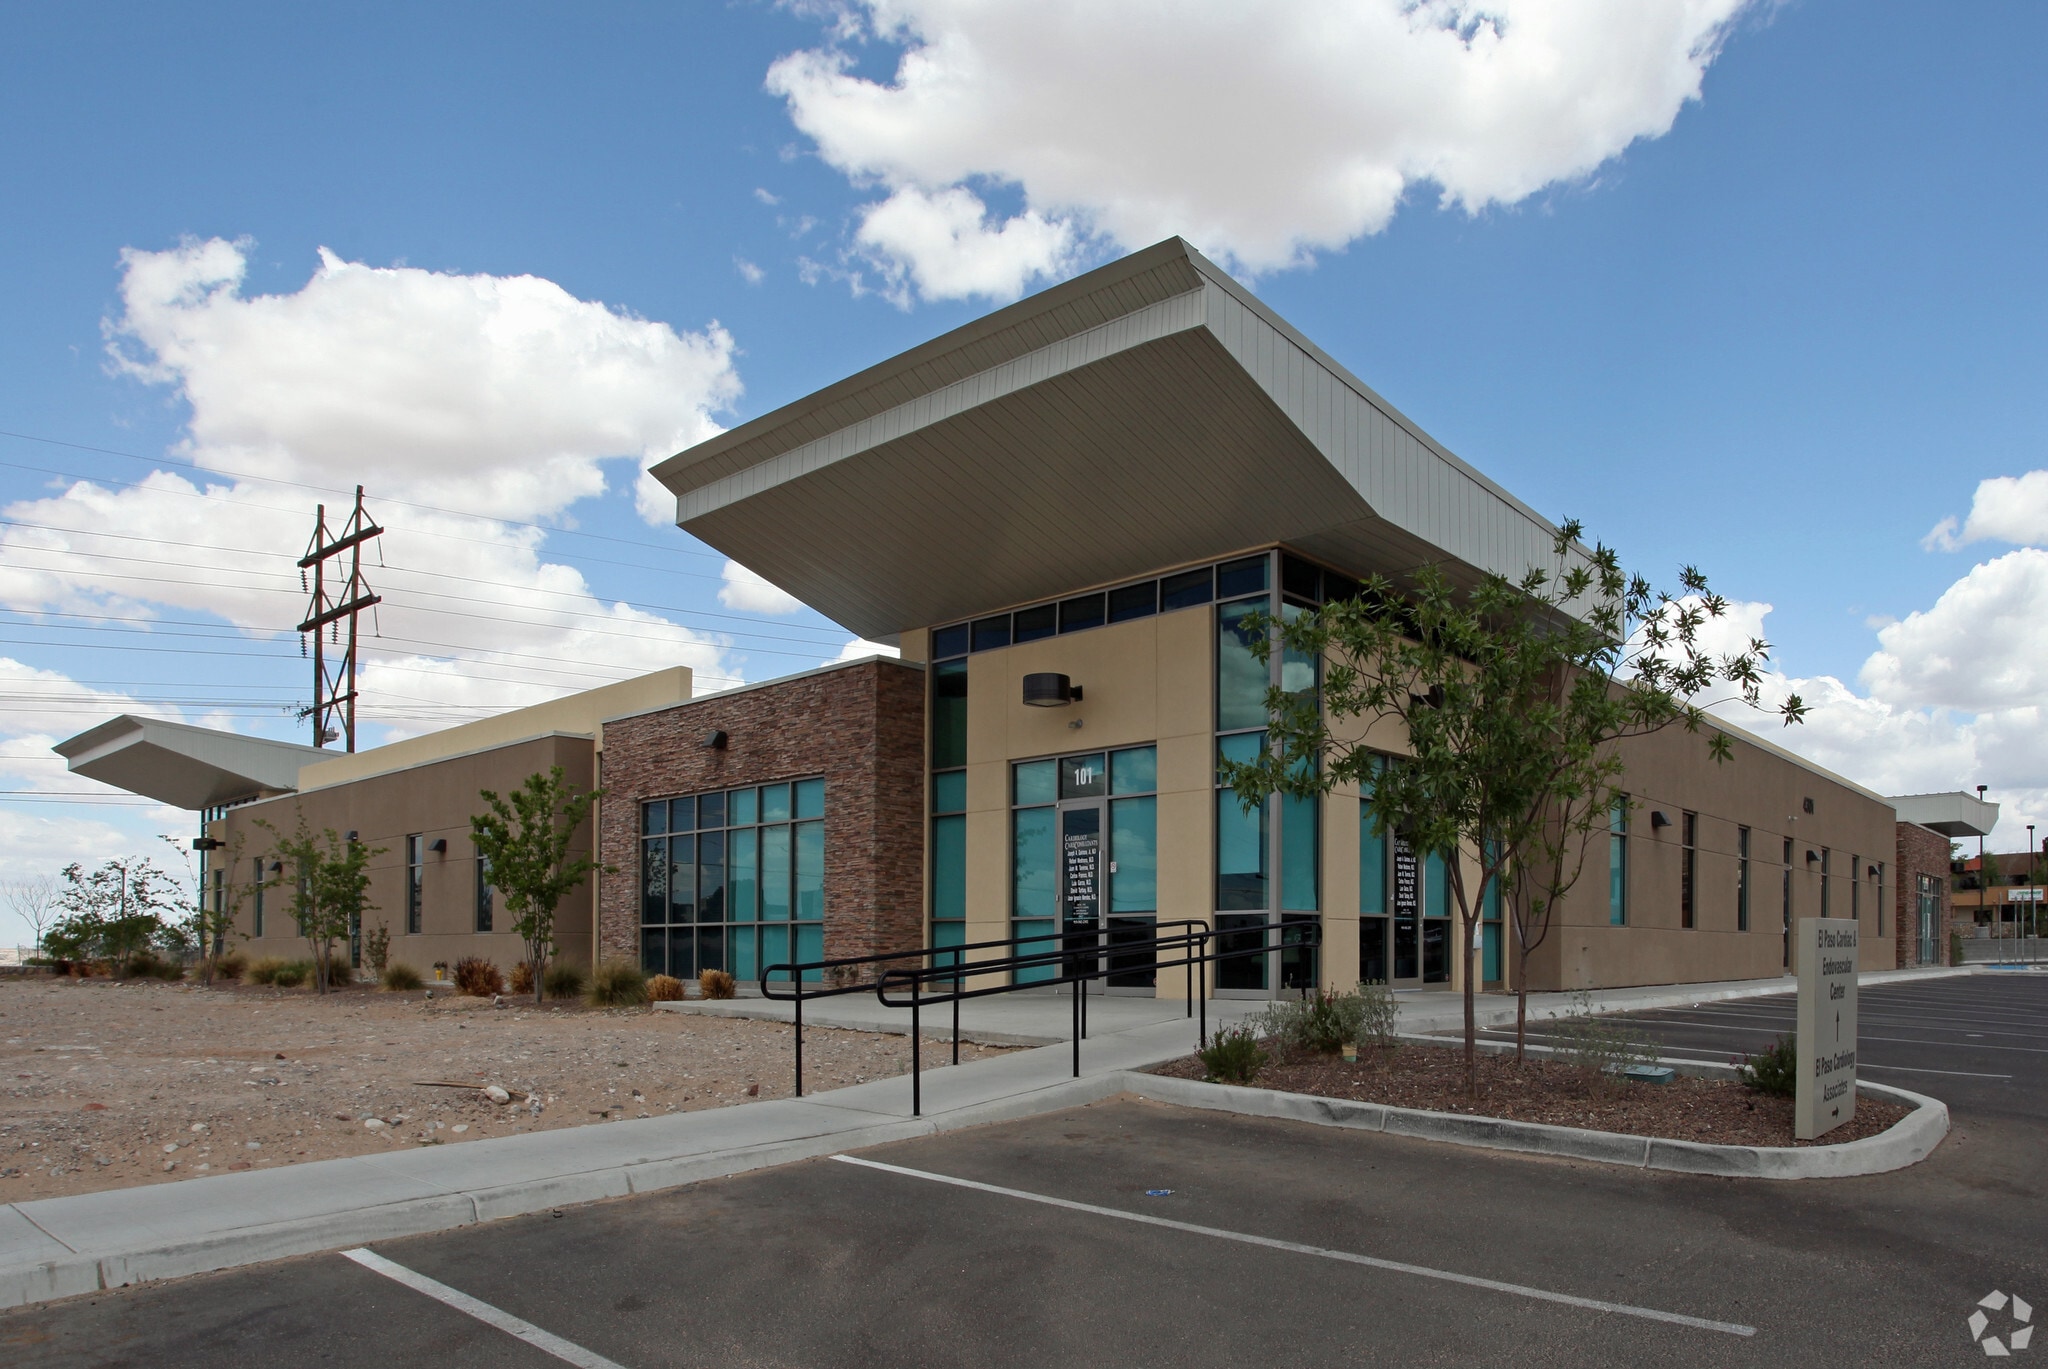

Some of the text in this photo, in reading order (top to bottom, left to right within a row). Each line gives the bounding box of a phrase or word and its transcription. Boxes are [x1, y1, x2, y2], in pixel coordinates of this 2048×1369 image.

[1074, 766, 1093, 786] 101
[1818, 929, 1857, 949] El Paso Cardiac &
[1823, 956, 1853, 976] Endovascular
[1830, 982, 1846, 1001] Center
[1815, 1050, 1855, 1078] El Paso Cardiology
[1823, 1080, 1848, 1103] Associates
